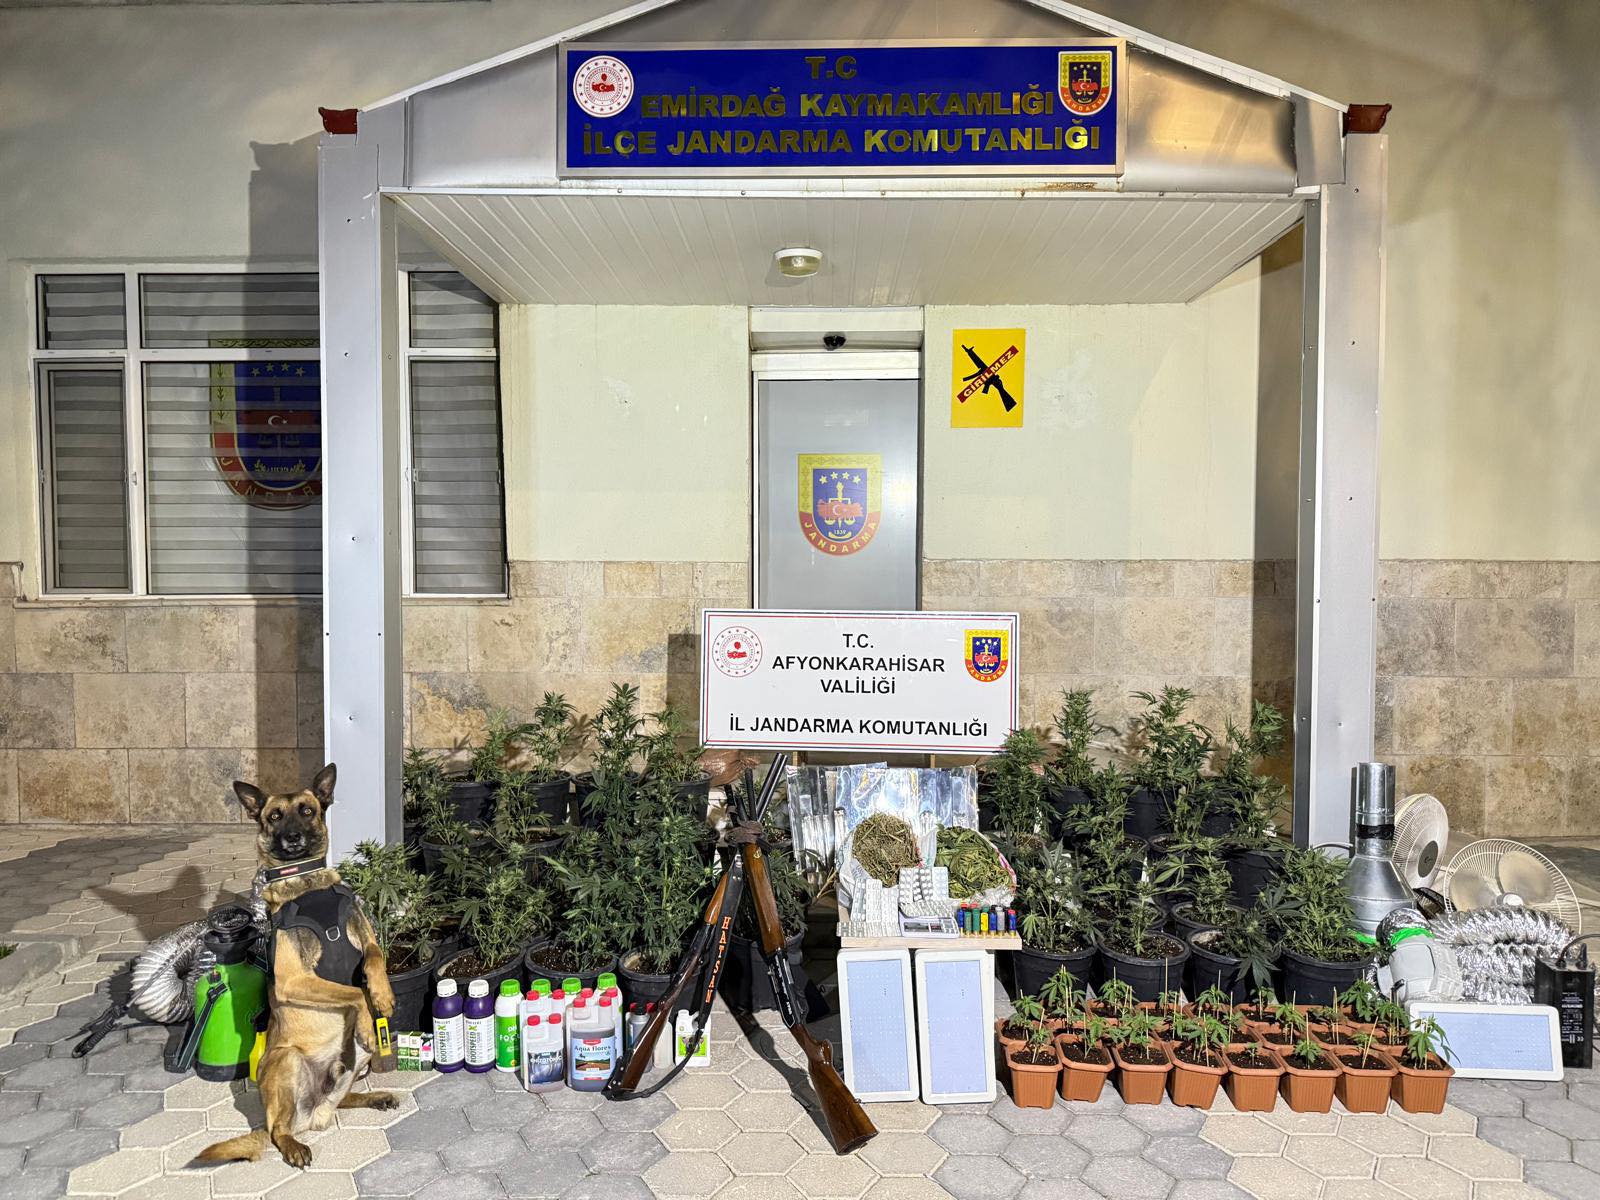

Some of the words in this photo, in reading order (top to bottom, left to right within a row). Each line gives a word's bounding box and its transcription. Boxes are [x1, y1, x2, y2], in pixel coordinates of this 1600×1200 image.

[641, 87, 786, 118] EMİRDAĞ
[800, 83, 1053, 117] KAYMAKAMLIĞI
[666, 130, 853, 156] JANDARMA
[863, 119, 1100, 154] KOMUTANLIĞI
[804, 520, 877, 553] JANDARMA
[842, 633, 874, 649] T.C.
[772, 655, 945, 672] AFYONKARAHİSAR
[820, 677, 896, 694] VALİLİĞİ
[729, 713, 745, 731] İL
[750, 717, 853, 734] JANDARMA
[859, 718, 988, 737] KOMUTANLIĞI
[705, 916, 731, 1003] HATSAN
[439, 1031, 447, 1062] ROOTSPEED
[469, 1031, 477, 1063] ROOTSPEED
